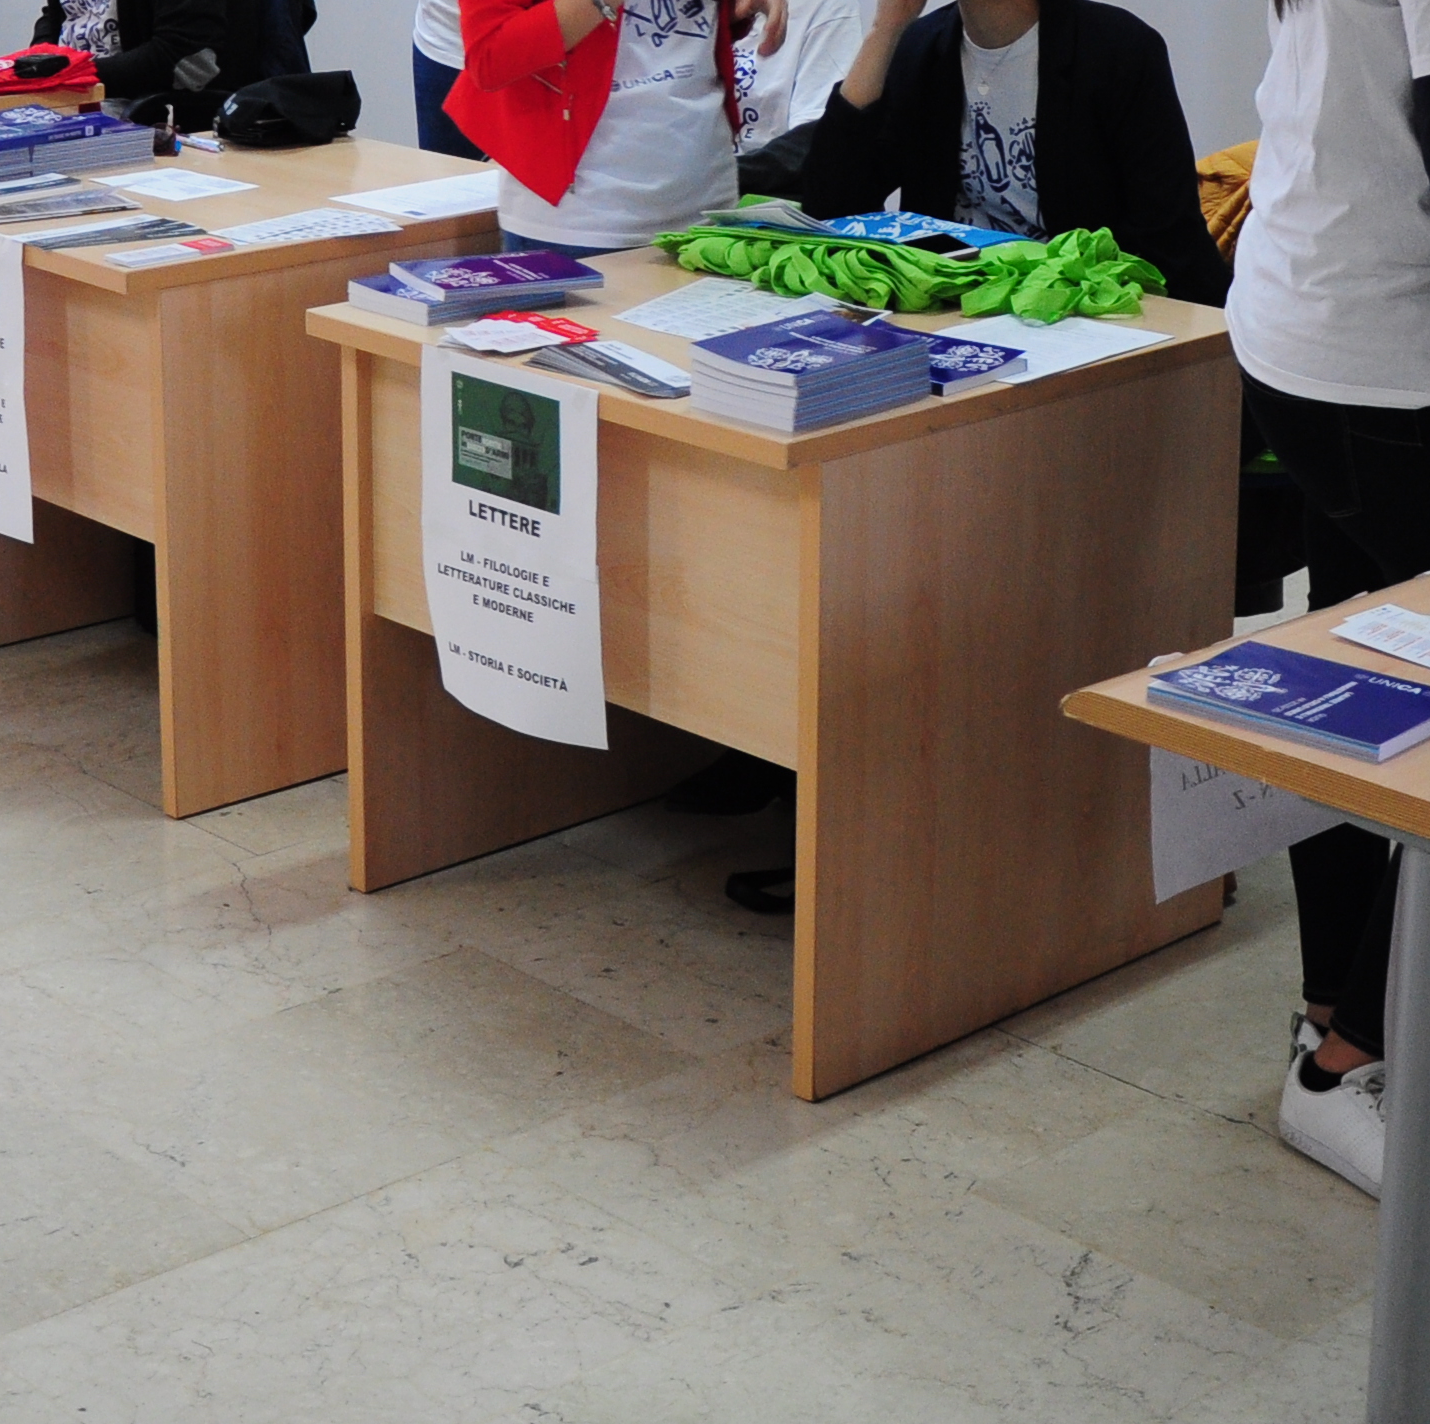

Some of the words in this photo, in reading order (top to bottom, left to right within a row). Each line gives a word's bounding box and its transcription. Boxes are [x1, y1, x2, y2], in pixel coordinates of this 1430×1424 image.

[623, 69, 675, 89] UNICA
[0, 337, 5, 349] E
[1, 398, 6, 408] E
[469, 499, 541, 538] LETTERE
[460, 550, 474, 564] LM
[483, 557, 539, 584] FILOLOGIE
[542, 575, 550, 587] E
[437, 562, 510, 595] LETTERATURE
[512, 587, 576, 615] CLASSICHE
[472, 594, 480, 605] E
[482, 596, 534, 623] MODERNE
[449, 641, 461, 655] LM
[468, 650, 504, 673] STORIA
[507, 664, 514, 676] E
[517, 667, 568, 692] SOCIETÀ
[1368, 677, 1422, 695] UNICA
